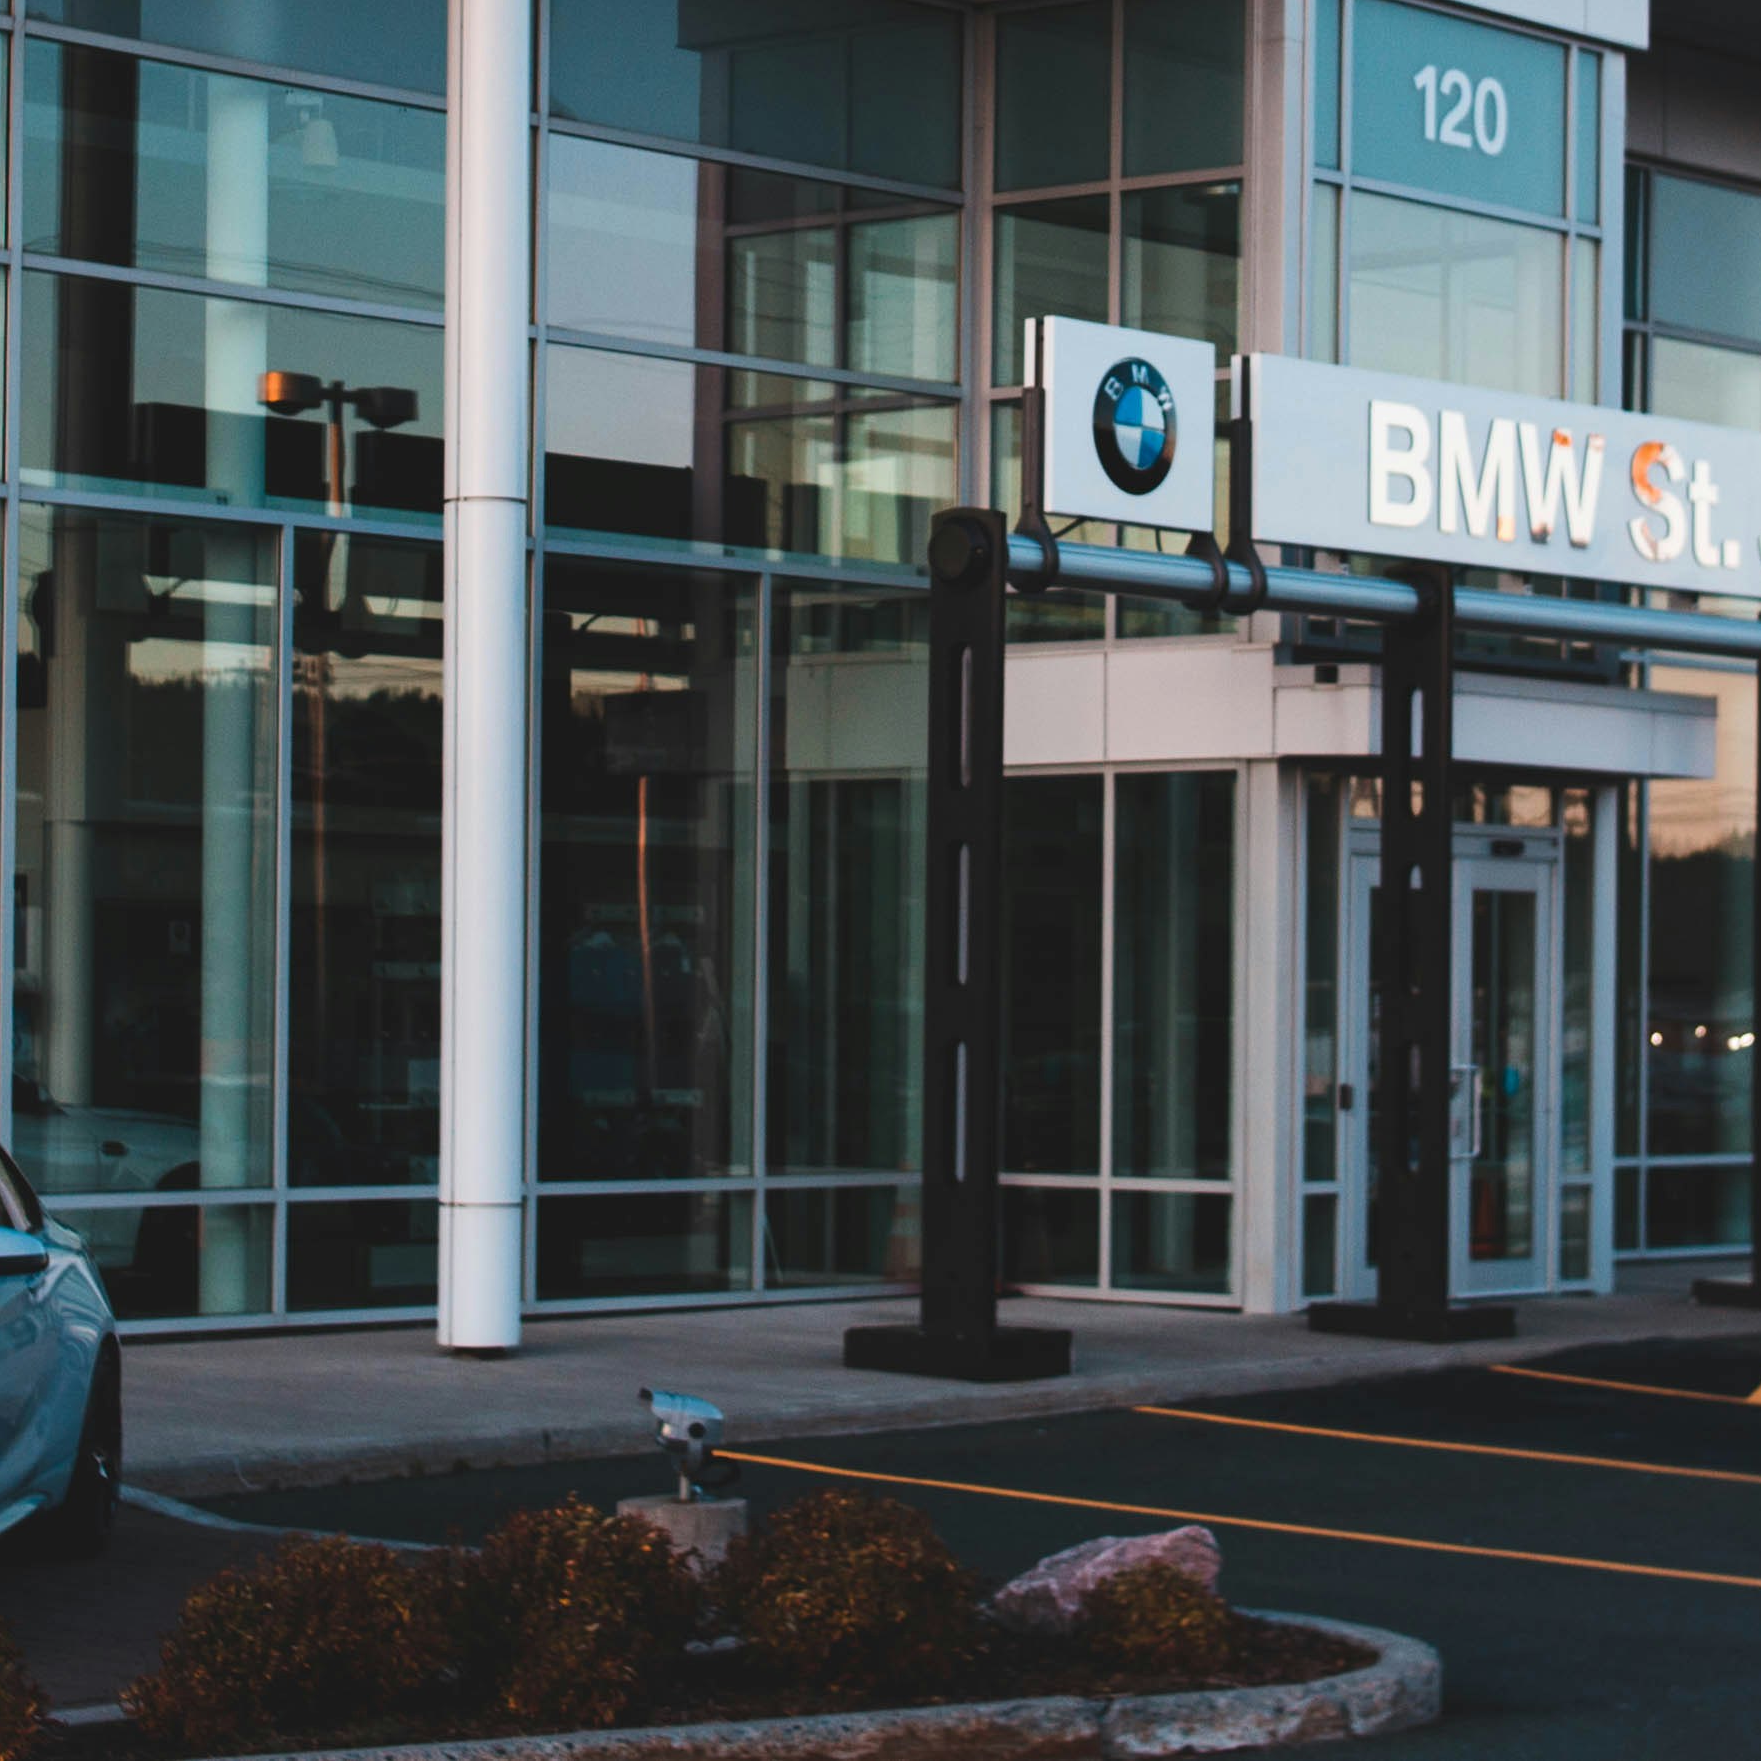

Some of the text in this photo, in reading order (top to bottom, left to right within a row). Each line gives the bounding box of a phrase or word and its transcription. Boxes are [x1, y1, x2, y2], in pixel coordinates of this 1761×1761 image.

[1413, 64, 1508, 157] 120
[1368, 399, 1606, 549] BMW
[1629, 440, 1741, 570] St.
